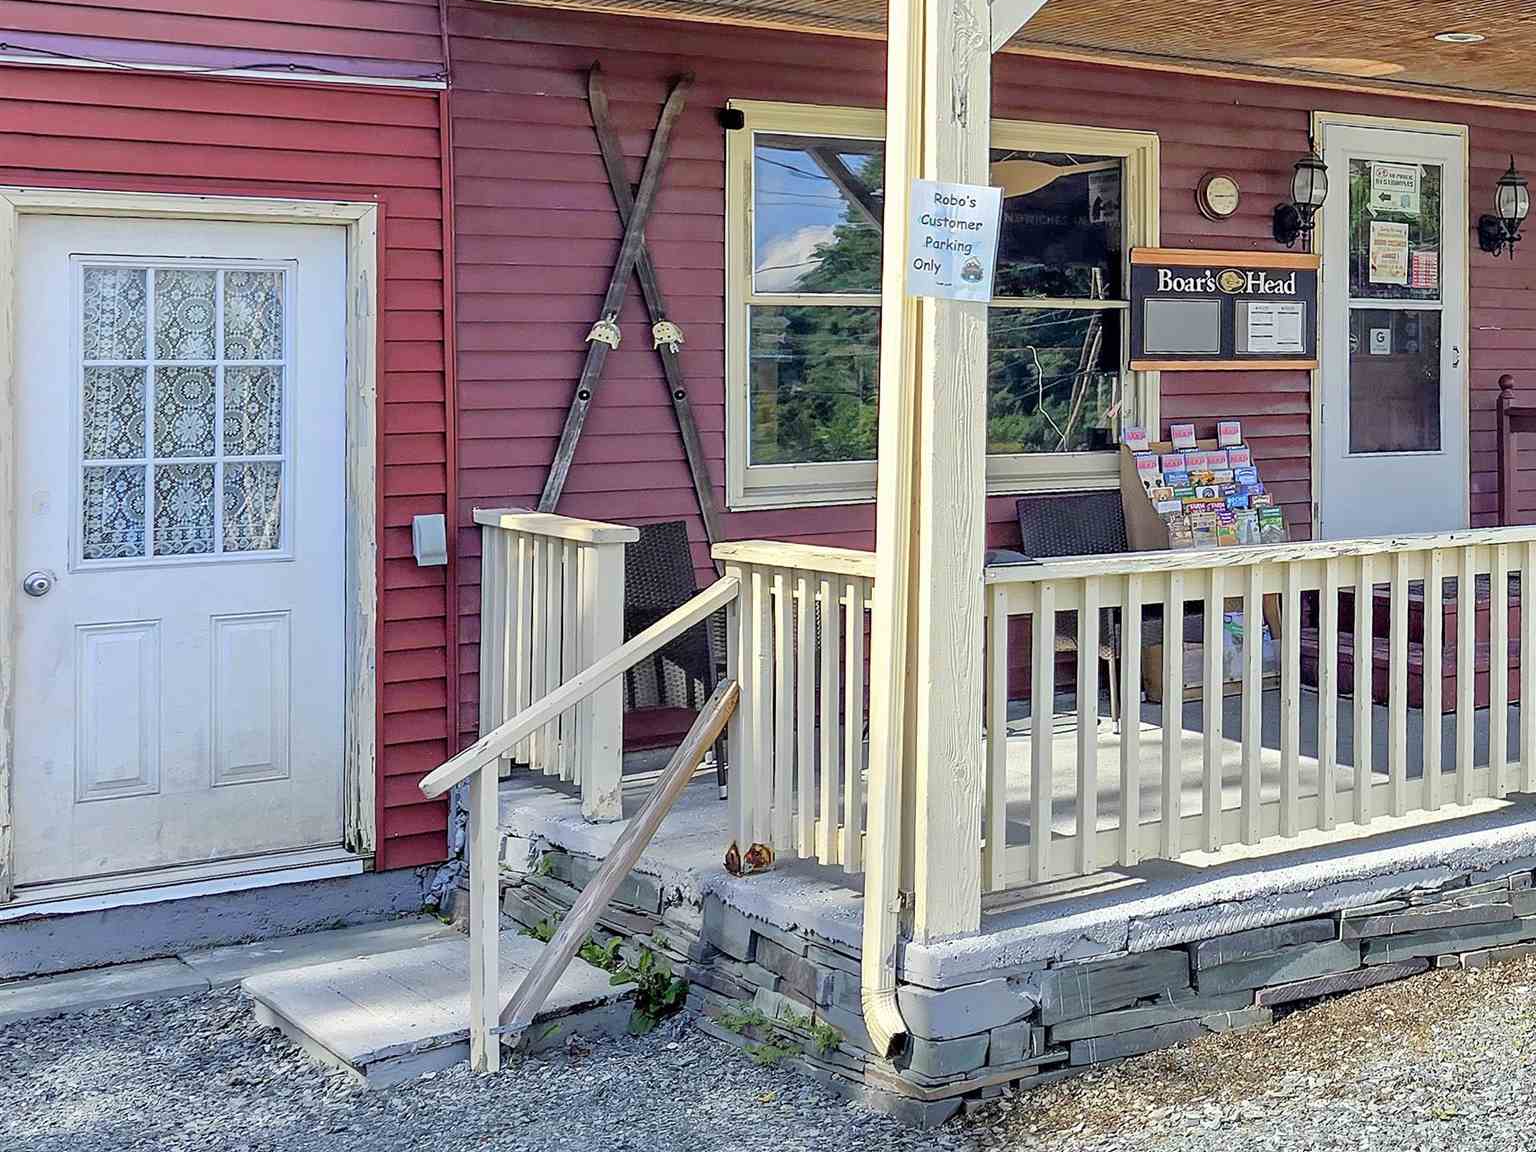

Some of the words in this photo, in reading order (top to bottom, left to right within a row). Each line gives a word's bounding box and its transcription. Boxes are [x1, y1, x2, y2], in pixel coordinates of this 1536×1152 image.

[933, 192, 977, 209] Robo's
[920, 213, 984, 232] Customer
[925, 235, 973, 256] Parking
[912, 257, 942, 276] Only
[1157, 268, 1216, 293] Boar's
[1246, 270, 1296, 295] Head
